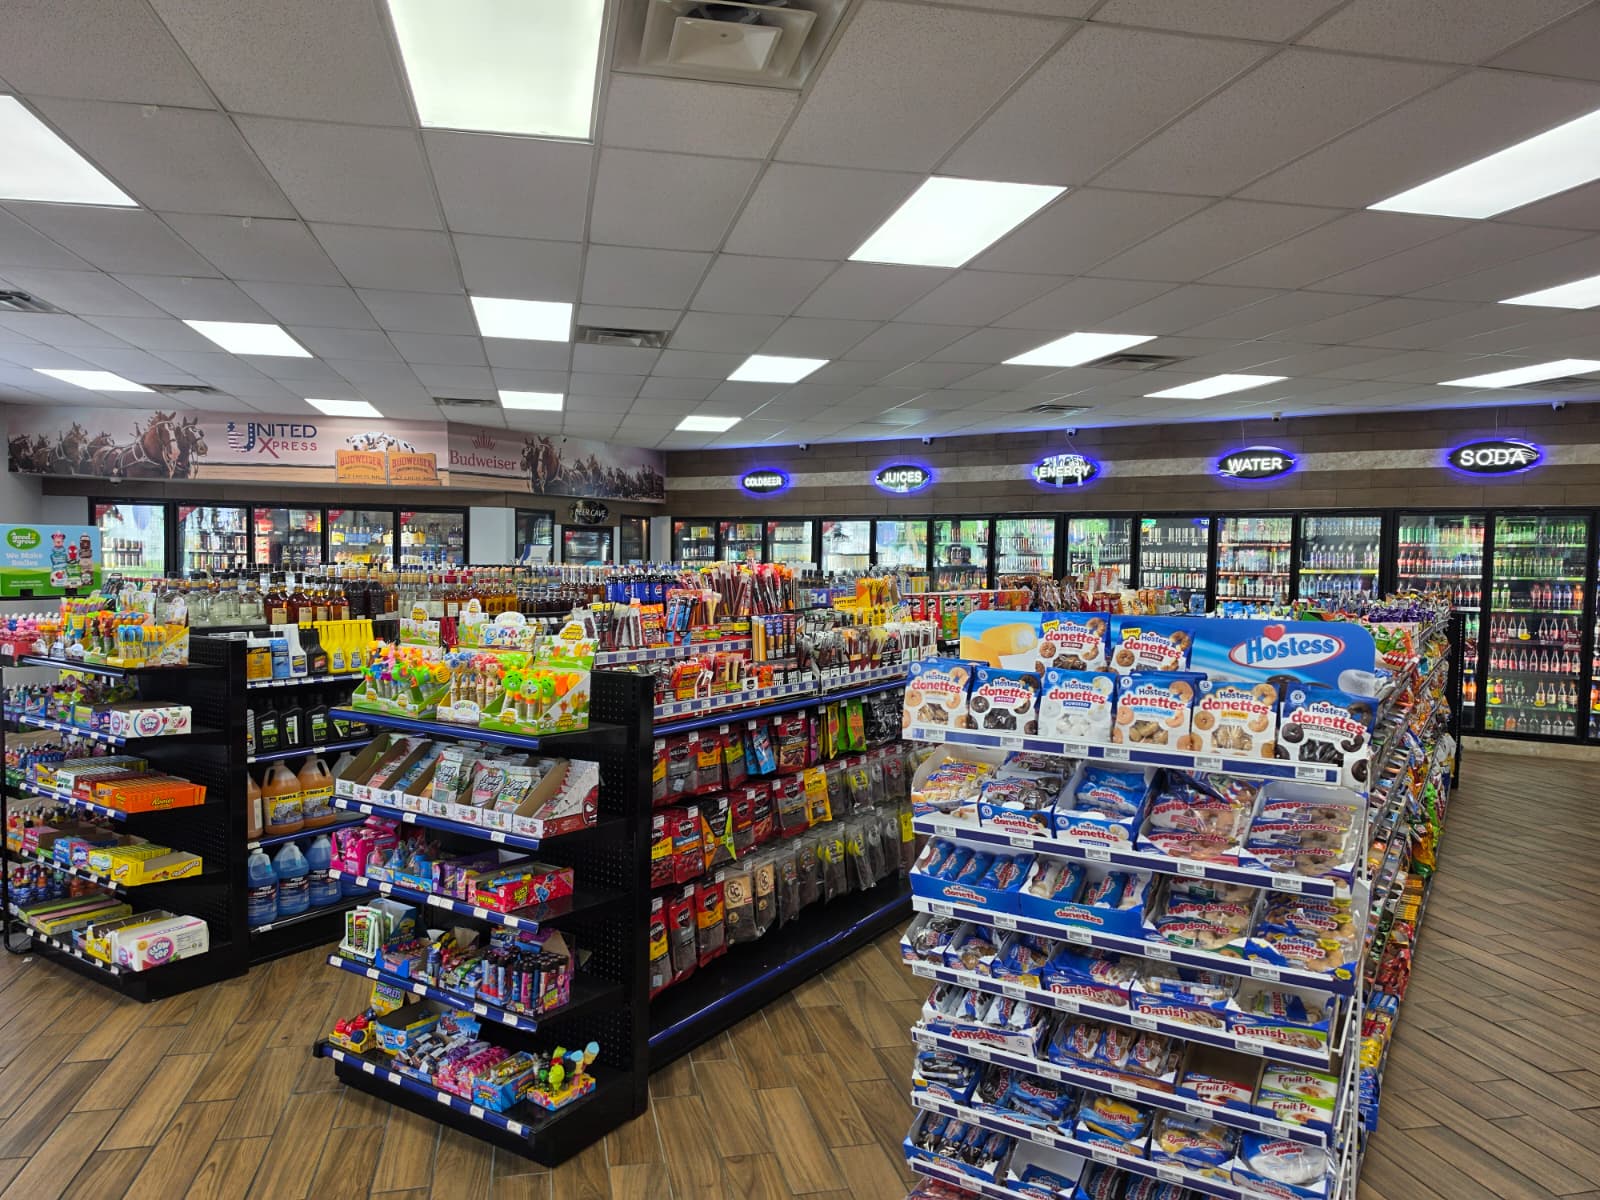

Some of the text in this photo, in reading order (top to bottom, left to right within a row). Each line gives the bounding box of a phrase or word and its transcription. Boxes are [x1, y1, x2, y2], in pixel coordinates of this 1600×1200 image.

[227, 421, 318, 452] UNITED
[258, 437, 318, 459] XPRESS
[340, 454, 383, 469] BUDWEISER
[391, 456, 435, 472] BUDWEISER
[450, 451, 517, 471] Budweiser
[1226, 457, 1283, 472] WATER
[1459, 449, 1528, 467] SODA
[883, 471, 923, 484] JUICES
[1038, 464, 1091, 479] ENERGY
[1060, 623, 1088, 634] Hostess
[1045, 630, 1101, 646] donettes
[1141, 634, 1171, 647] Hostess
[1123, 640, 1182, 660] donettes
[1246, 636, 1335, 665] Hostess
[926, 674, 951, 682] Hostess
[994, 680, 1022, 689] Hostess
[911, 680, 961, 694] donettes
[978, 685, 1033, 699] donettes
[1064, 682, 1094, 691] Hostess
[1138, 688, 1170, 698] Hostess
[1049, 689, 1106, 704] donettes
[1219, 691, 1253, 701] Hostess
[1121, 697, 1185, 711] donettes
[1201, 699, 1269, 716] donettes
[1312, 705, 1348, 718] Hostess
[1291, 714, 1366, 736] donettes
[992, 818, 1039, 831] donettes
[1069, 829, 1120, 842] donettes
[1056, 910, 1103, 924] donettes
[1275, 942, 1326, 958] donettes
[1051, 984, 1097, 997] Danish
[1140, 1005, 1190, 1019] Danish
[951, 1027, 1006, 1044] donettes
[1234, 1024, 1288, 1040] Danish
[1278, 1075, 1322, 1086] Fruit Pie
[1195, 1083, 1239, 1095] Fruit Pie
[1272, 1101, 1317, 1113] Fruit Pie
